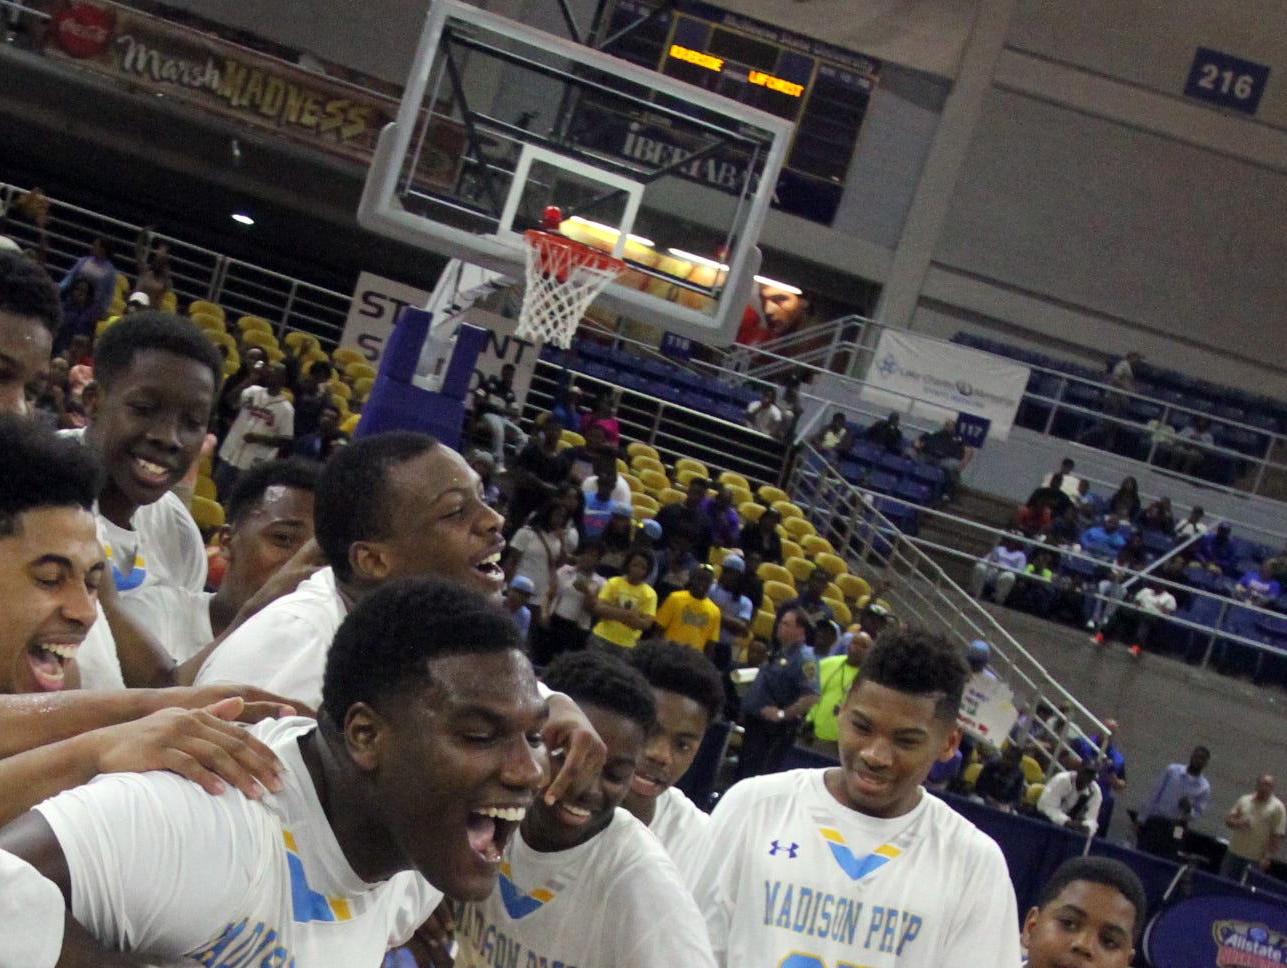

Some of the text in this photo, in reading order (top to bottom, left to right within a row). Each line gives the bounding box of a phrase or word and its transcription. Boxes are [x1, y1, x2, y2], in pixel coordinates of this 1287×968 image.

[1198, 64, 1255, 99] 216
[218, 60, 373, 140] MADNESS
[1224, 933, 1282, 964] Allstate
